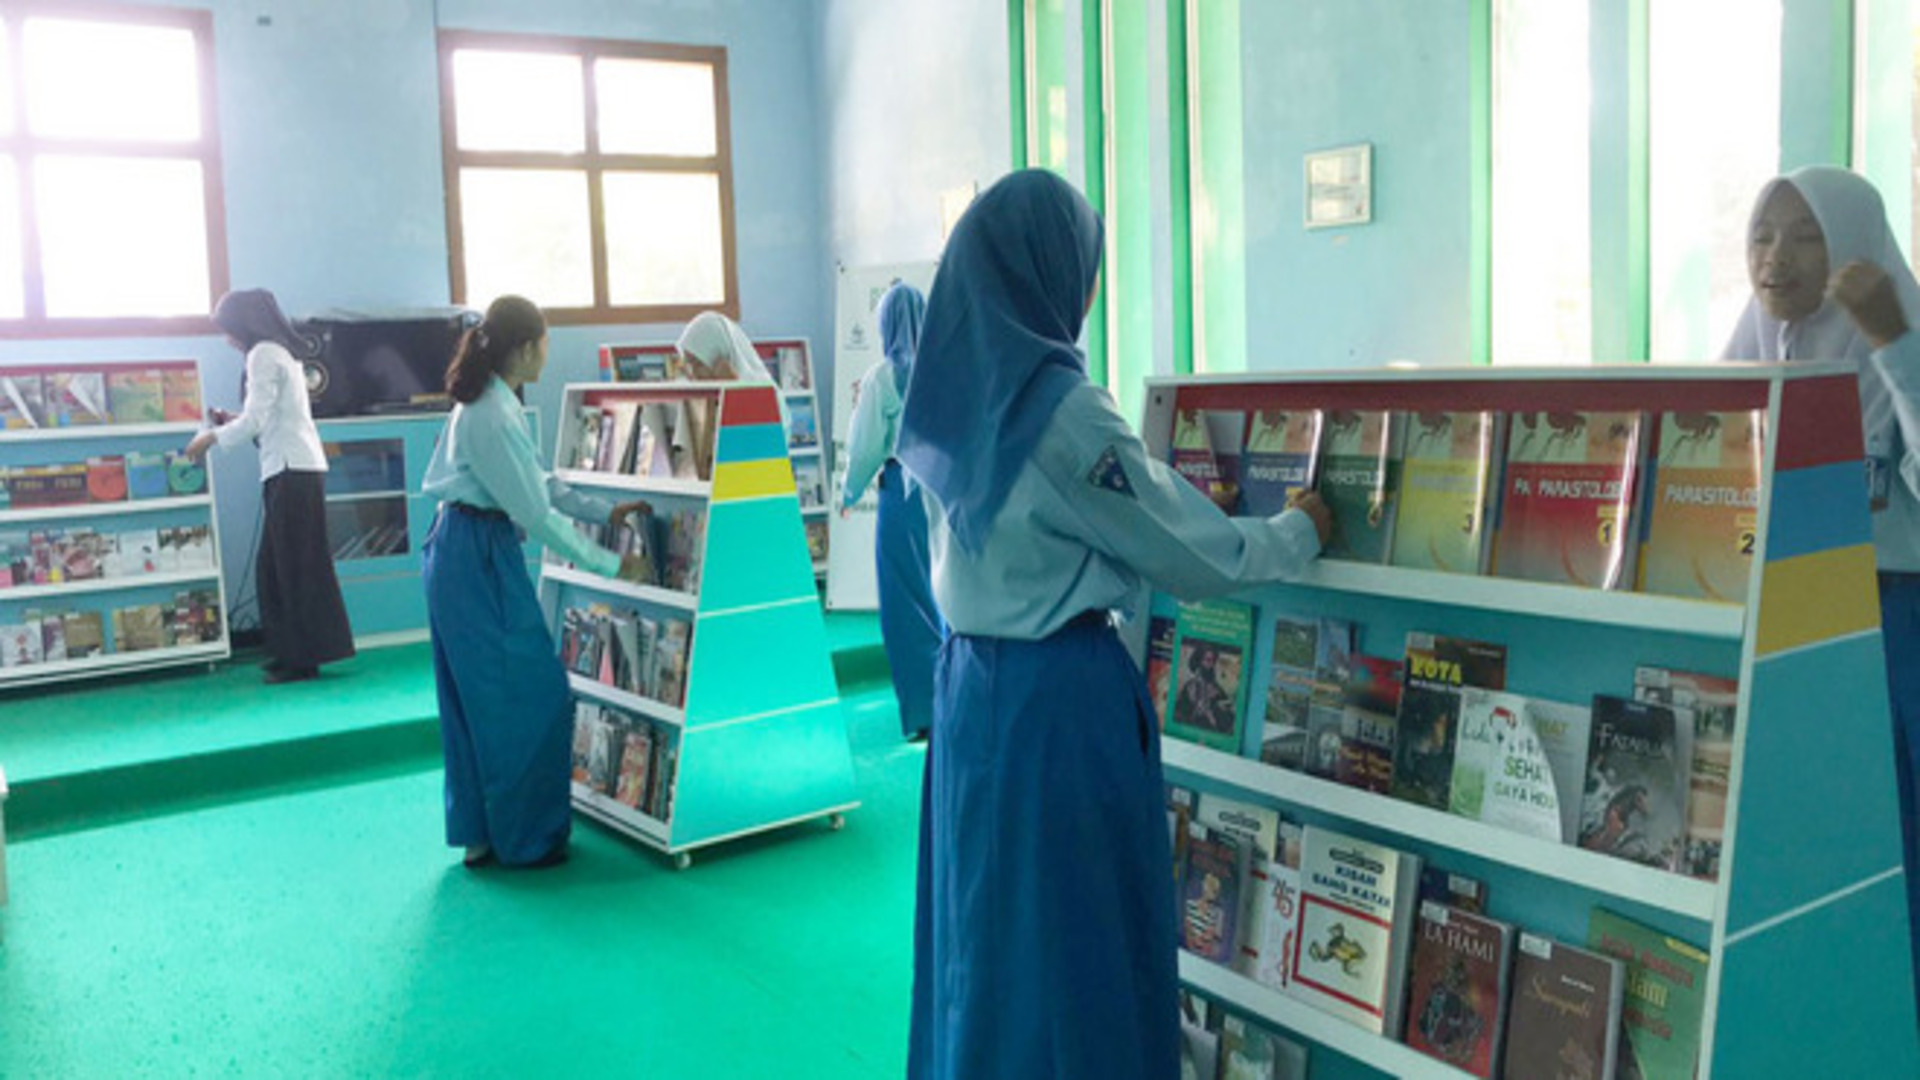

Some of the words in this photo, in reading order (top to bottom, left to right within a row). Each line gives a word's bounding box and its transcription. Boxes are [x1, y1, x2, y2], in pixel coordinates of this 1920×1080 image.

[1602, 522, 1613, 544] 1
[1742, 532, 1755, 555] 2
[1410, 652, 1462, 686] KOTA
